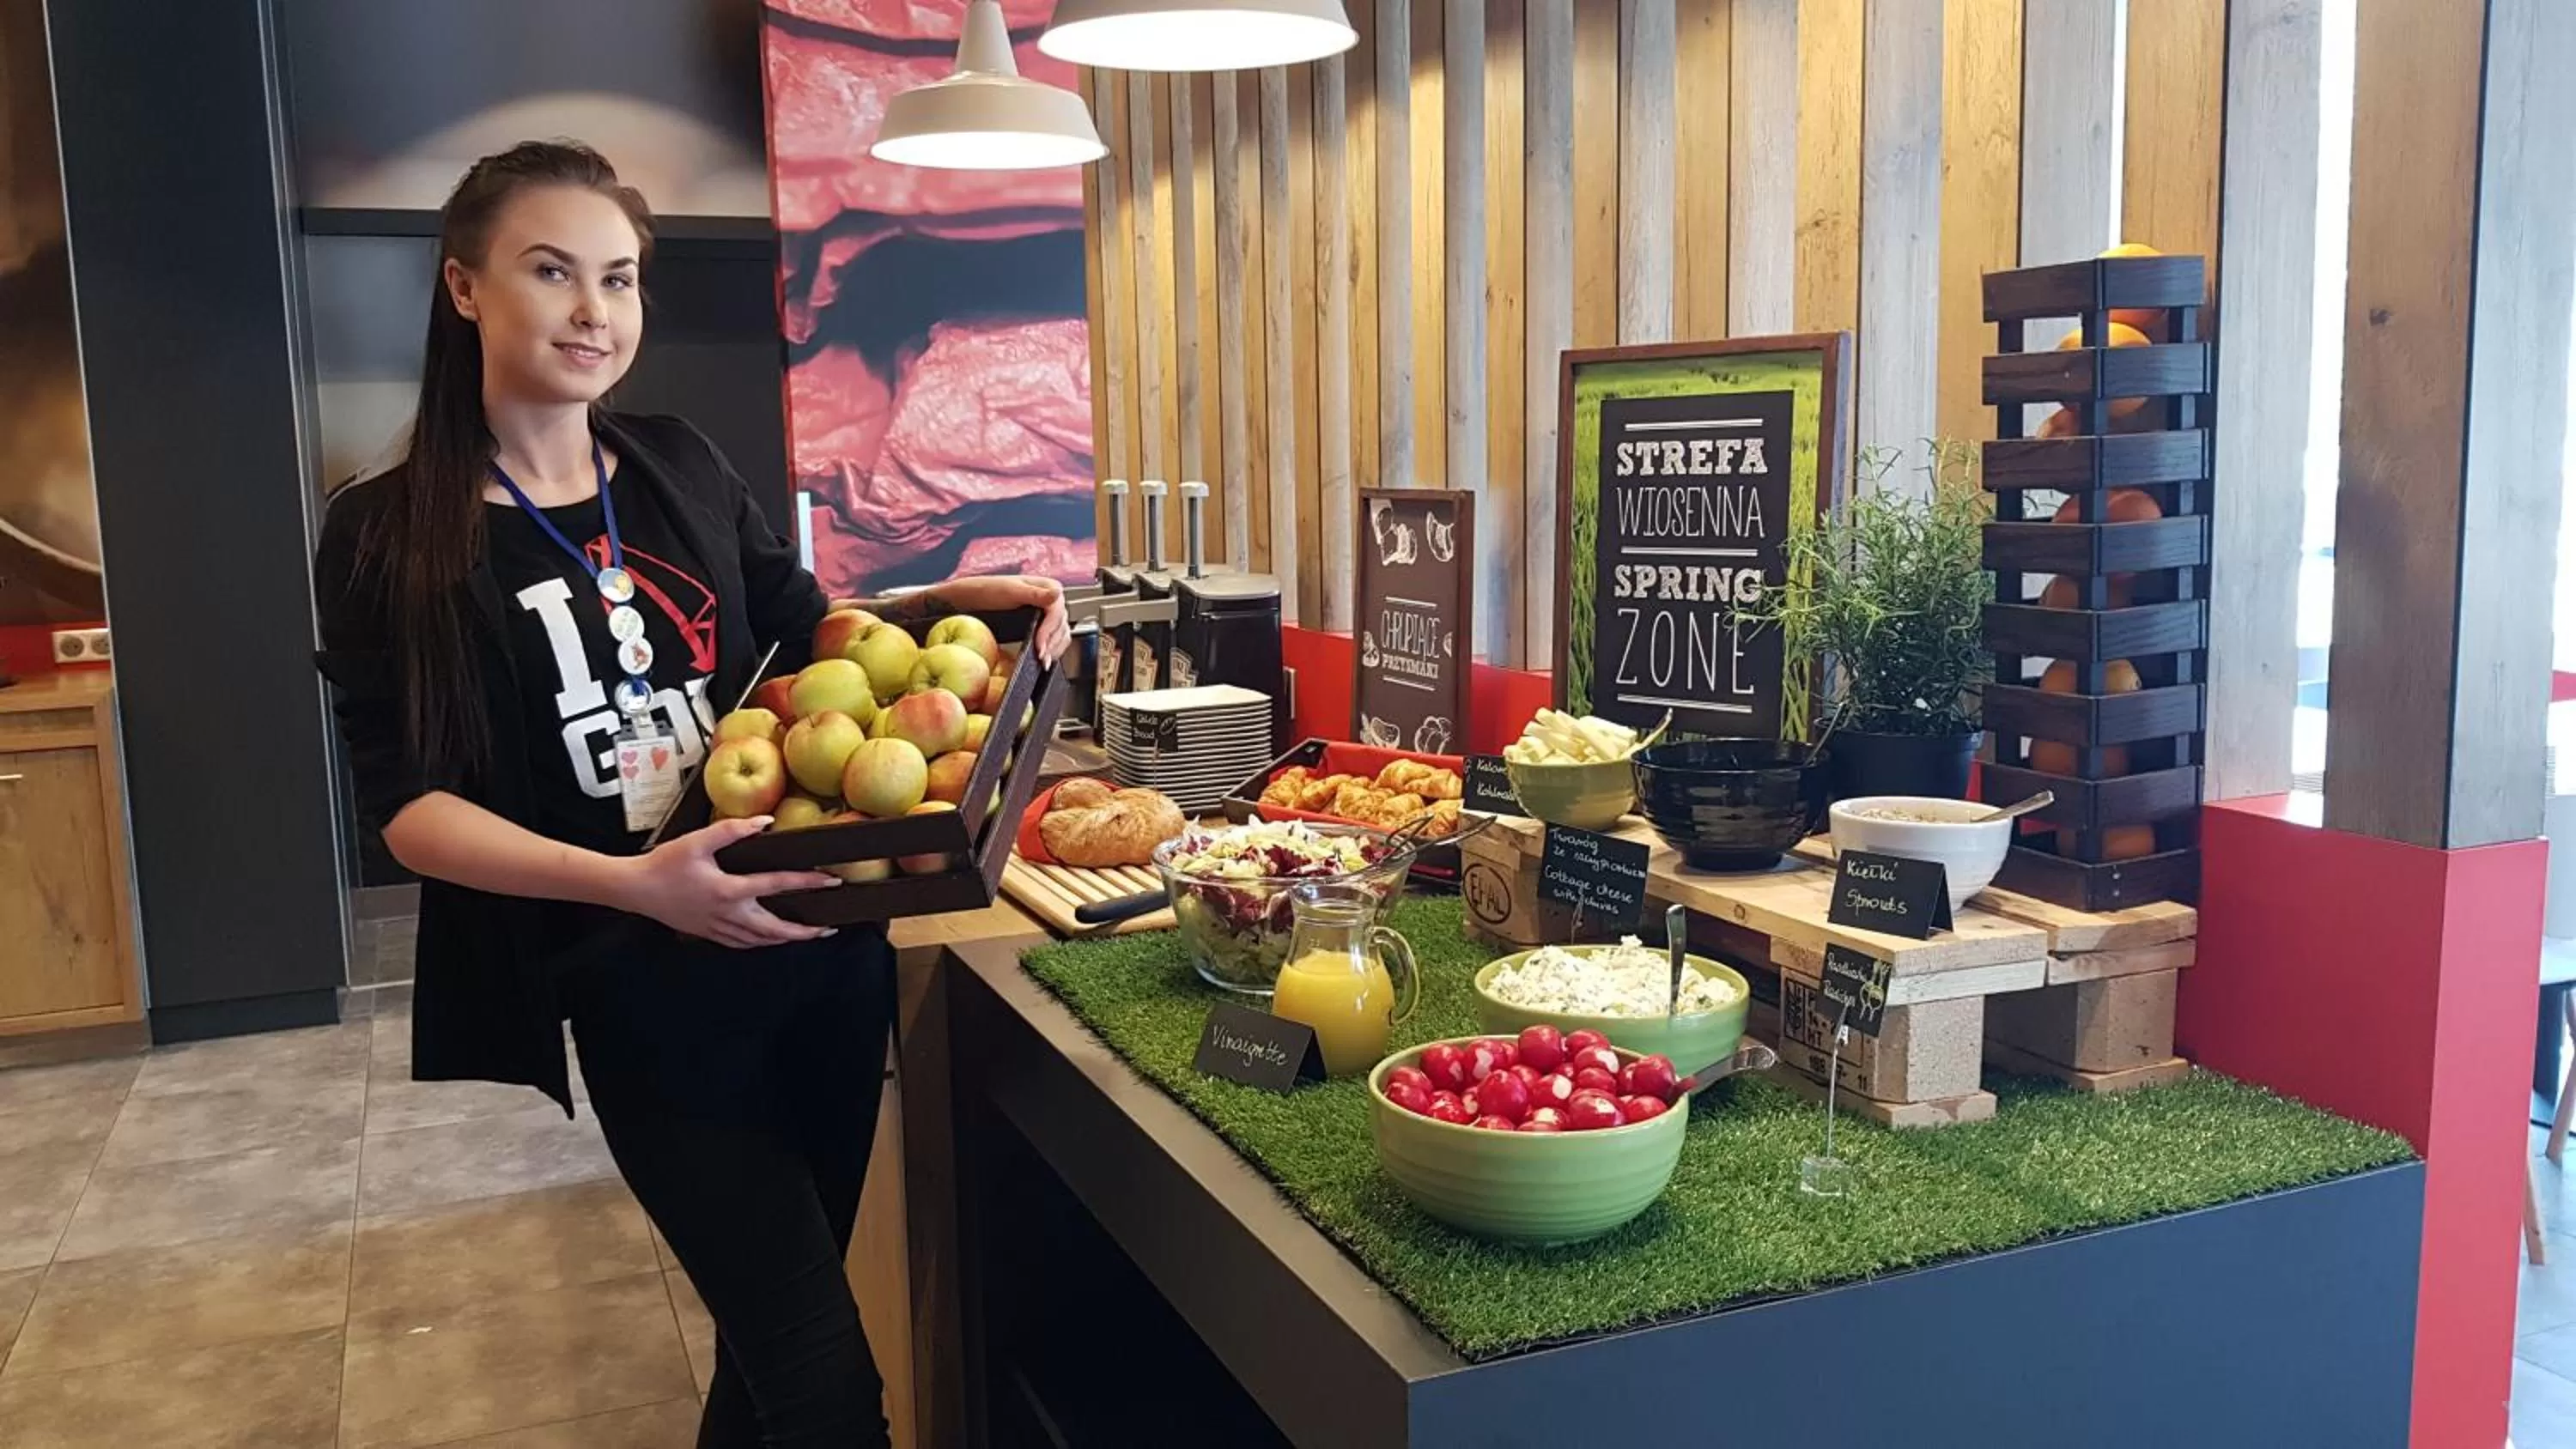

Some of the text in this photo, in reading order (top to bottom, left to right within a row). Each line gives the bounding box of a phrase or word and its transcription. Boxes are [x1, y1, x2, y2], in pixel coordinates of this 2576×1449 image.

[1616, 438, 1769, 476] STREFA
[1616, 484, 1765, 538] WIOSENNA
[1613, 565, 1765, 603] SPRING
[516, 577, 608, 719] I
[1615, 609, 1755, 695] ZONE
[1844, 888, 1909, 918] Sprouts
